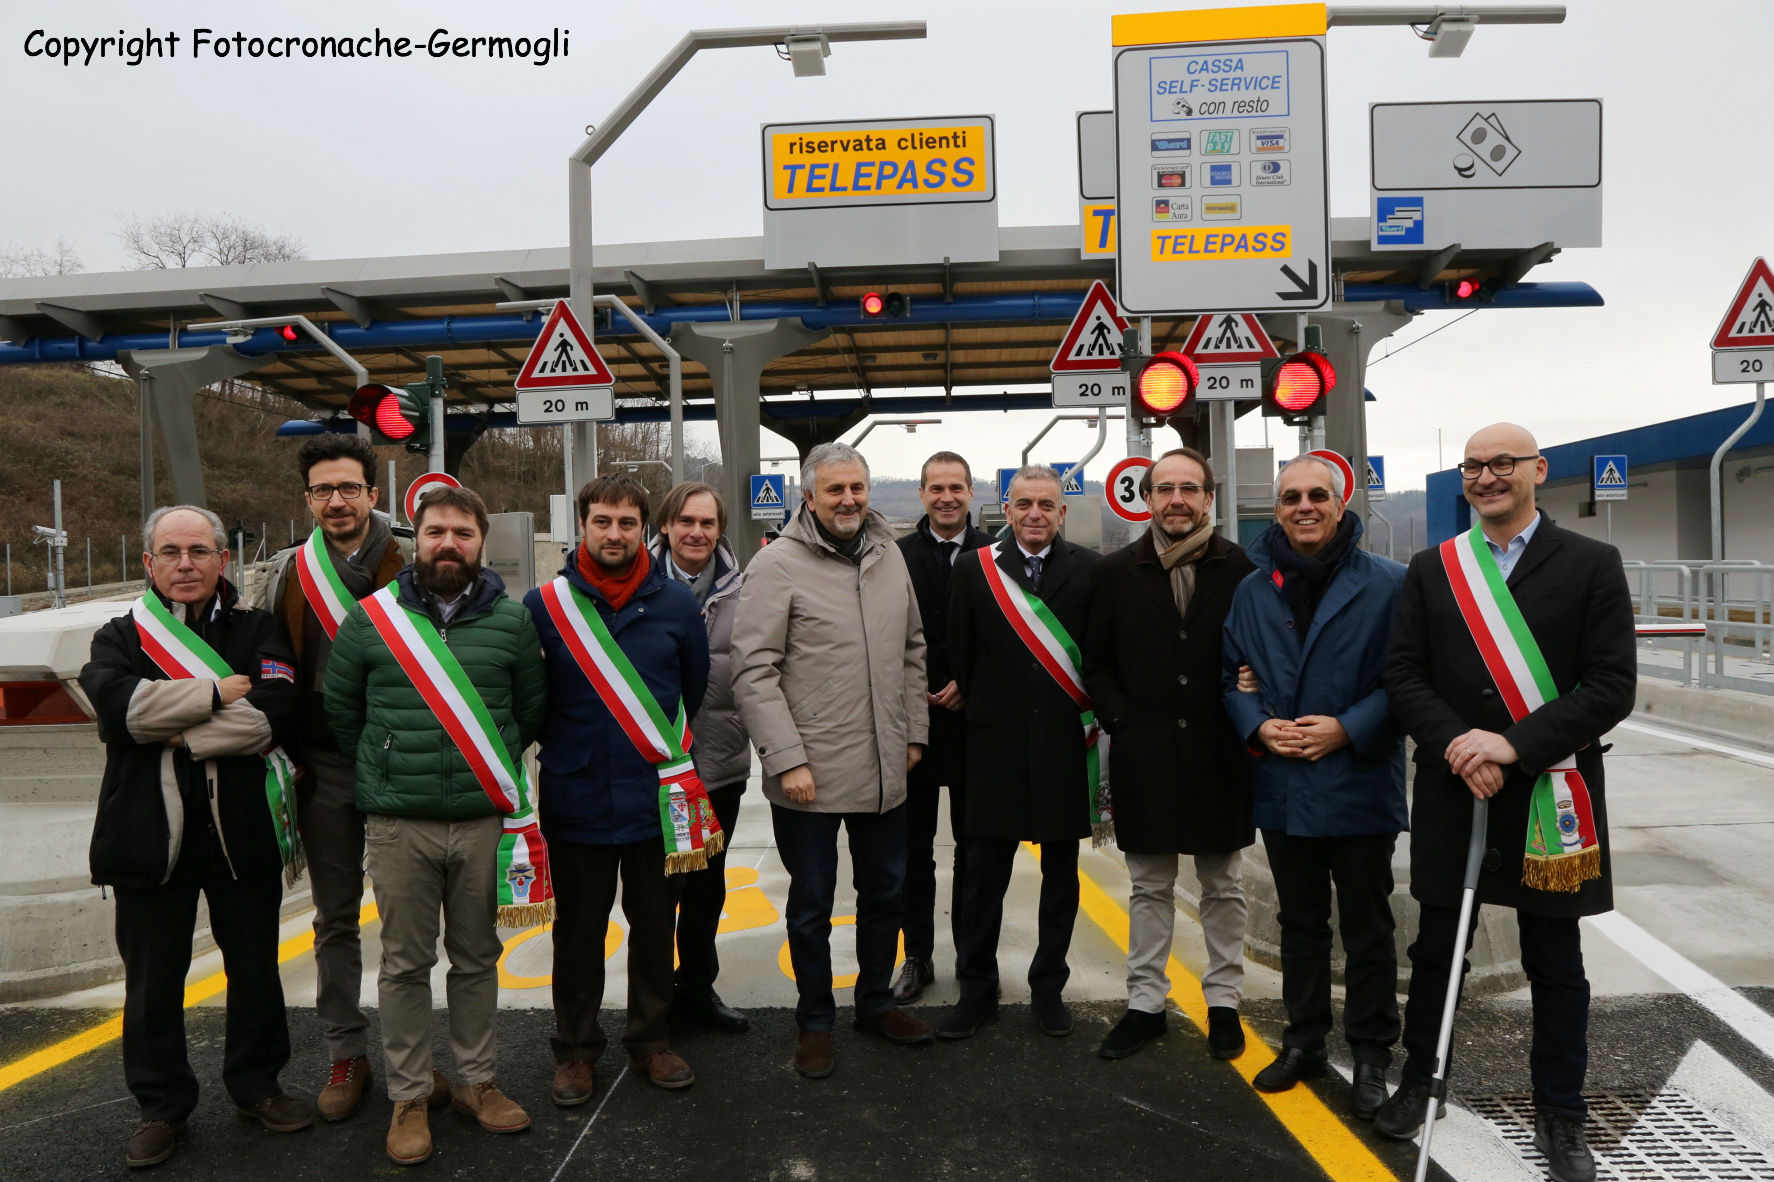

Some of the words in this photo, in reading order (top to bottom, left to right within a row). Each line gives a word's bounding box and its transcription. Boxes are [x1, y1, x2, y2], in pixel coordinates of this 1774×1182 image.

[1186, 58, 1245, 75] CASSA
[1156, 75, 1282, 95] SELF-SERVICE
[1199, 101, 1226, 115] con
[1231, 96, 1269, 114] resto
[789, 134, 887, 155] riservata
[897, 130, 967, 151] clienti
[1208, 132, 1233, 143] FAST
[782, 156, 976, 194] TELEPASS
[1171, 202, 1189, 211] Carta
[1171, 211, 1188, 219] Aura
[1156, 231, 1287, 255] TELEPASS
[1740, 359, 1763, 373] 20
[1078, 383, 1102, 397] 20
[1112, 385, 1126, 396] m
[1207, 376, 1230, 390] 20
[1240, 378, 1254, 389] m
[543, 399, 565, 413] 20
[575, 401, 589, 411] m
[1120, 475, 1145, 503] 3
